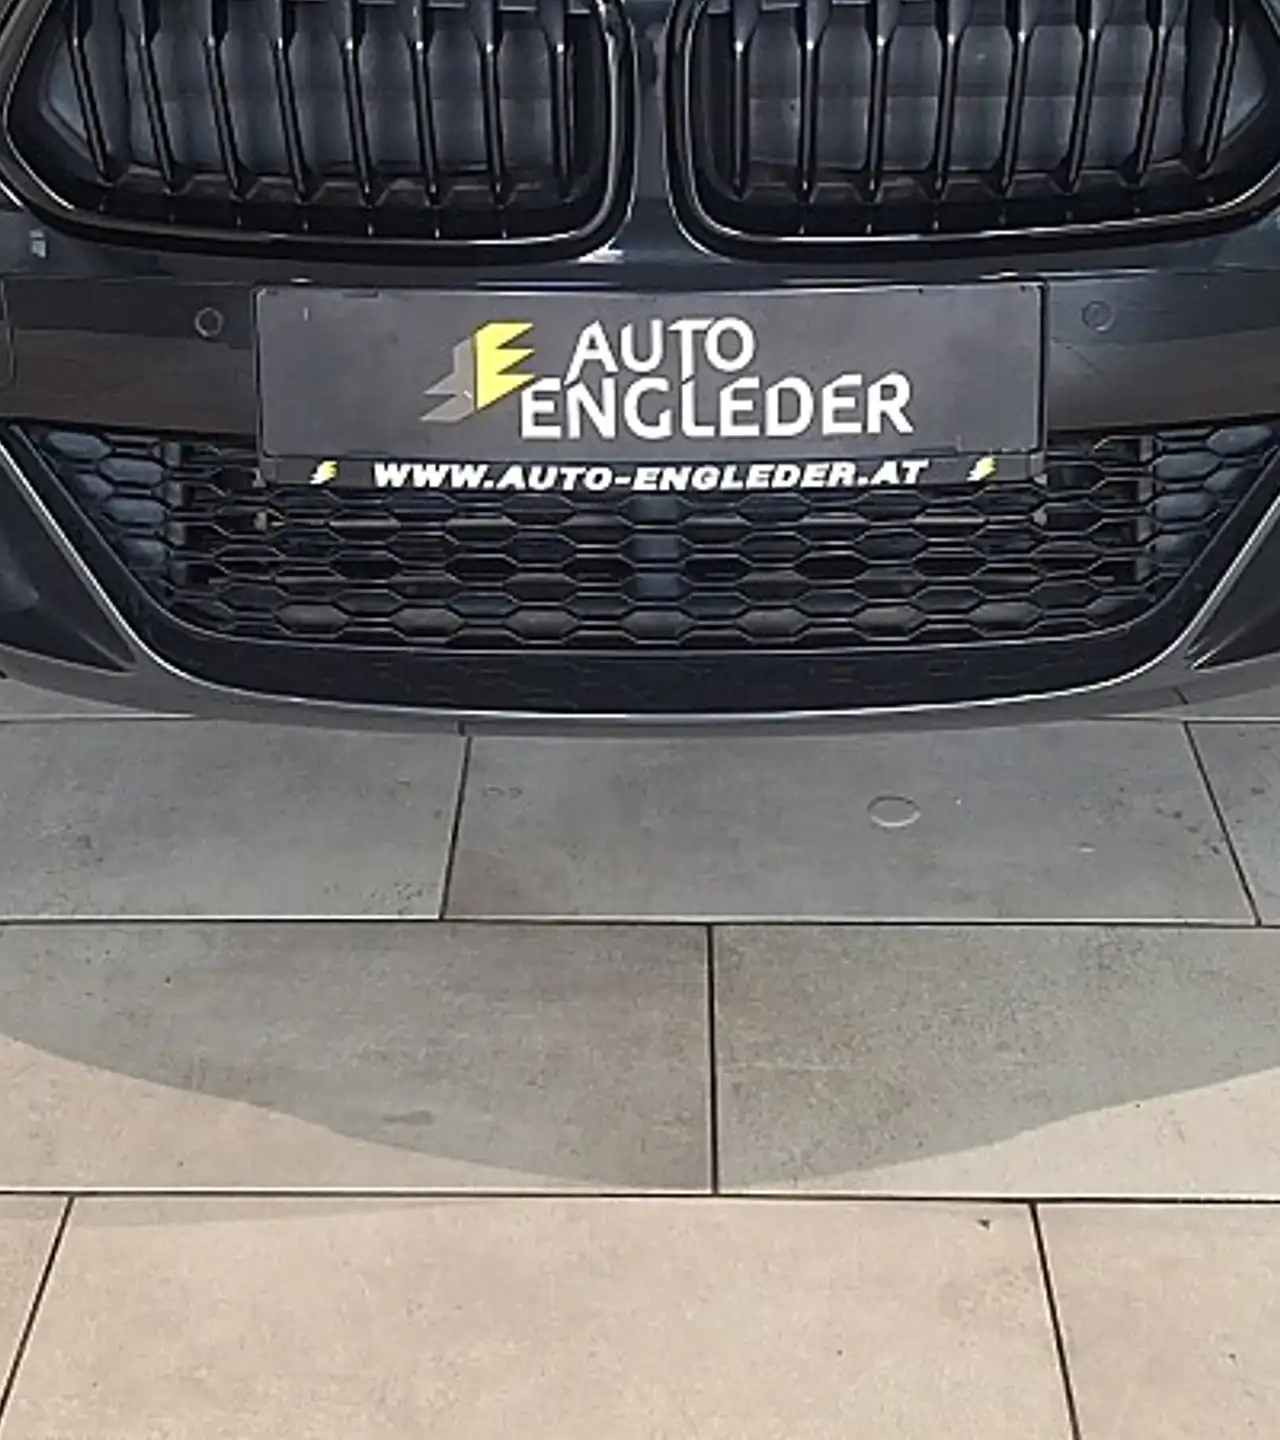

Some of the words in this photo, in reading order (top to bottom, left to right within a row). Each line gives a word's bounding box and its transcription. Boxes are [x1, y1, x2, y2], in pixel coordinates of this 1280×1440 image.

[564, 316, 756, 385] AUTO
[521, 371, 915, 441] ENGLEDER
[373, 460, 929, 492] WWW.AUTO-ENGLEDER.AT
